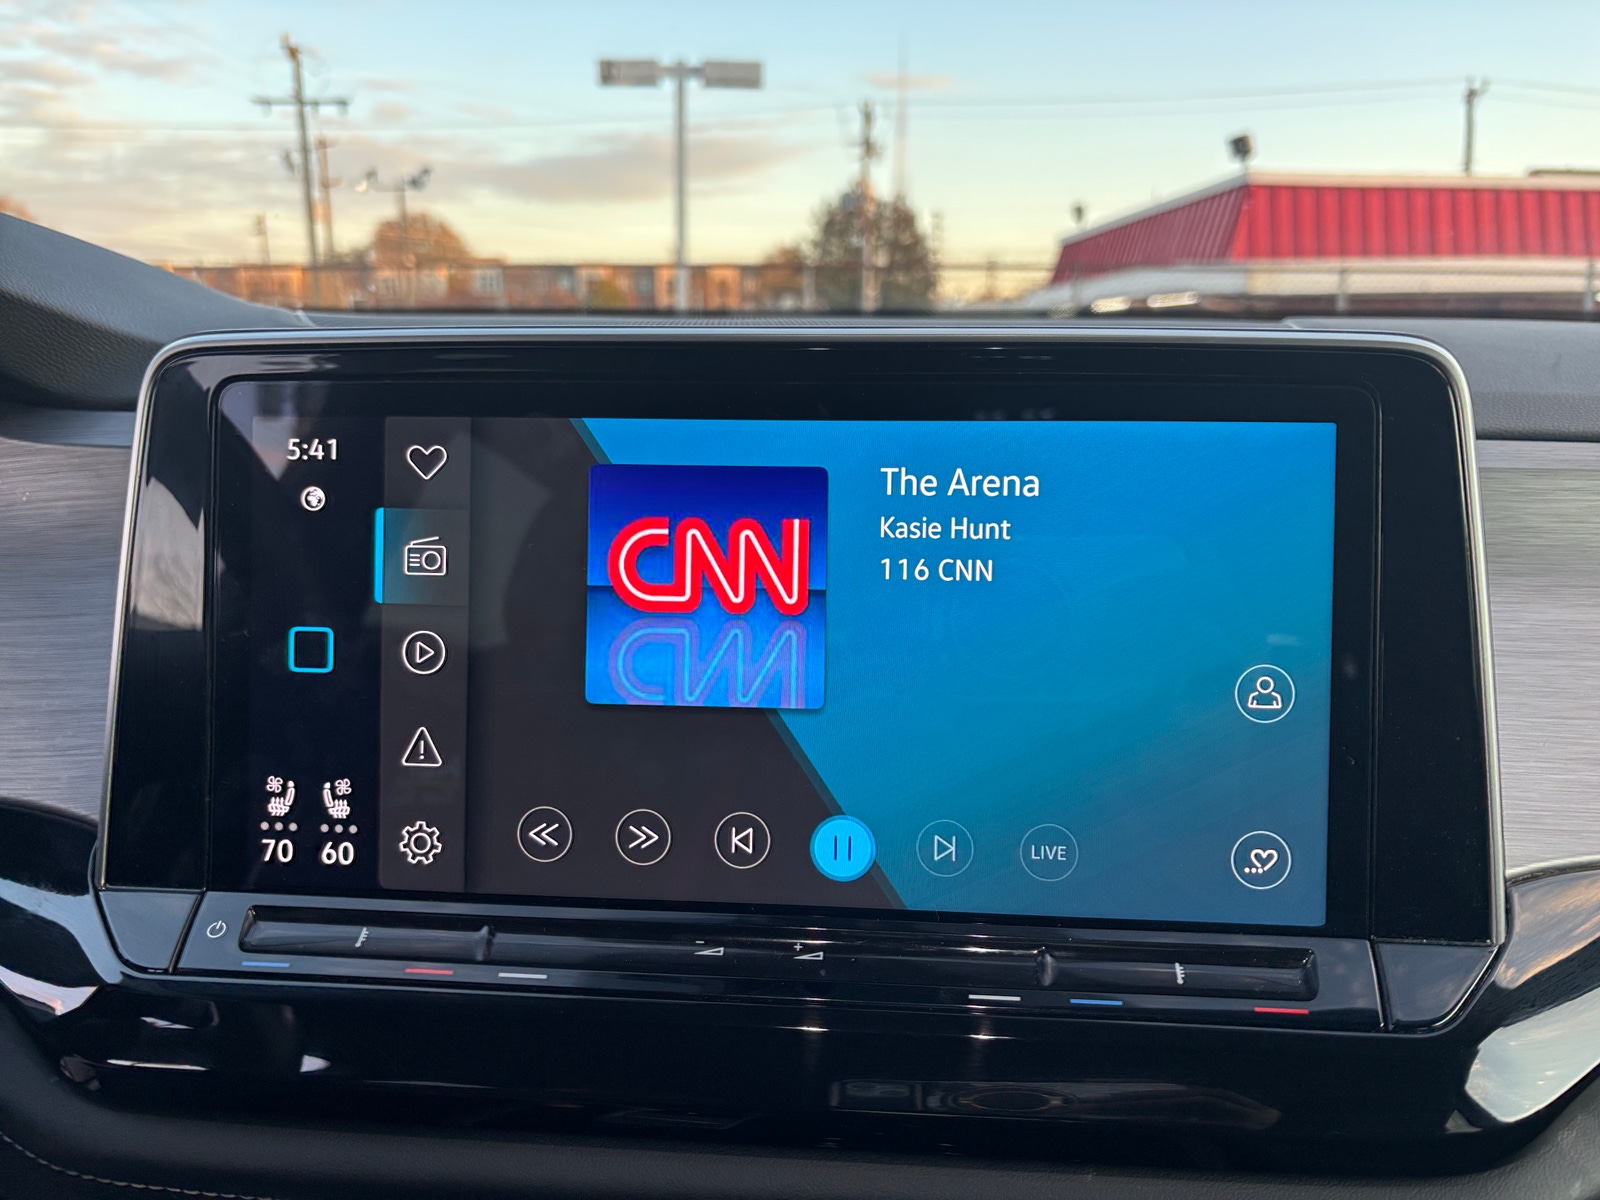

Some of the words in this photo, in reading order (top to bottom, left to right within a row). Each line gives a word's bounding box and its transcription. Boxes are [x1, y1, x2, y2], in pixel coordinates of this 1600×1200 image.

[286, 437, 339, 462] 5:41
[880, 466, 938, 497] The
[946, 467, 1040, 498] Arena
[880, 515, 942, 540] Kasie
[950, 516, 1011, 541] Hunt
[607, 516, 810, 616] CNN
[880, 557, 930, 582] 116
[938, 558, 993, 582] CNN
[261, 838, 294, 864] 70
[320, 841, 355, 867] 60
[1030, 844, 1067, 861] LIVE
